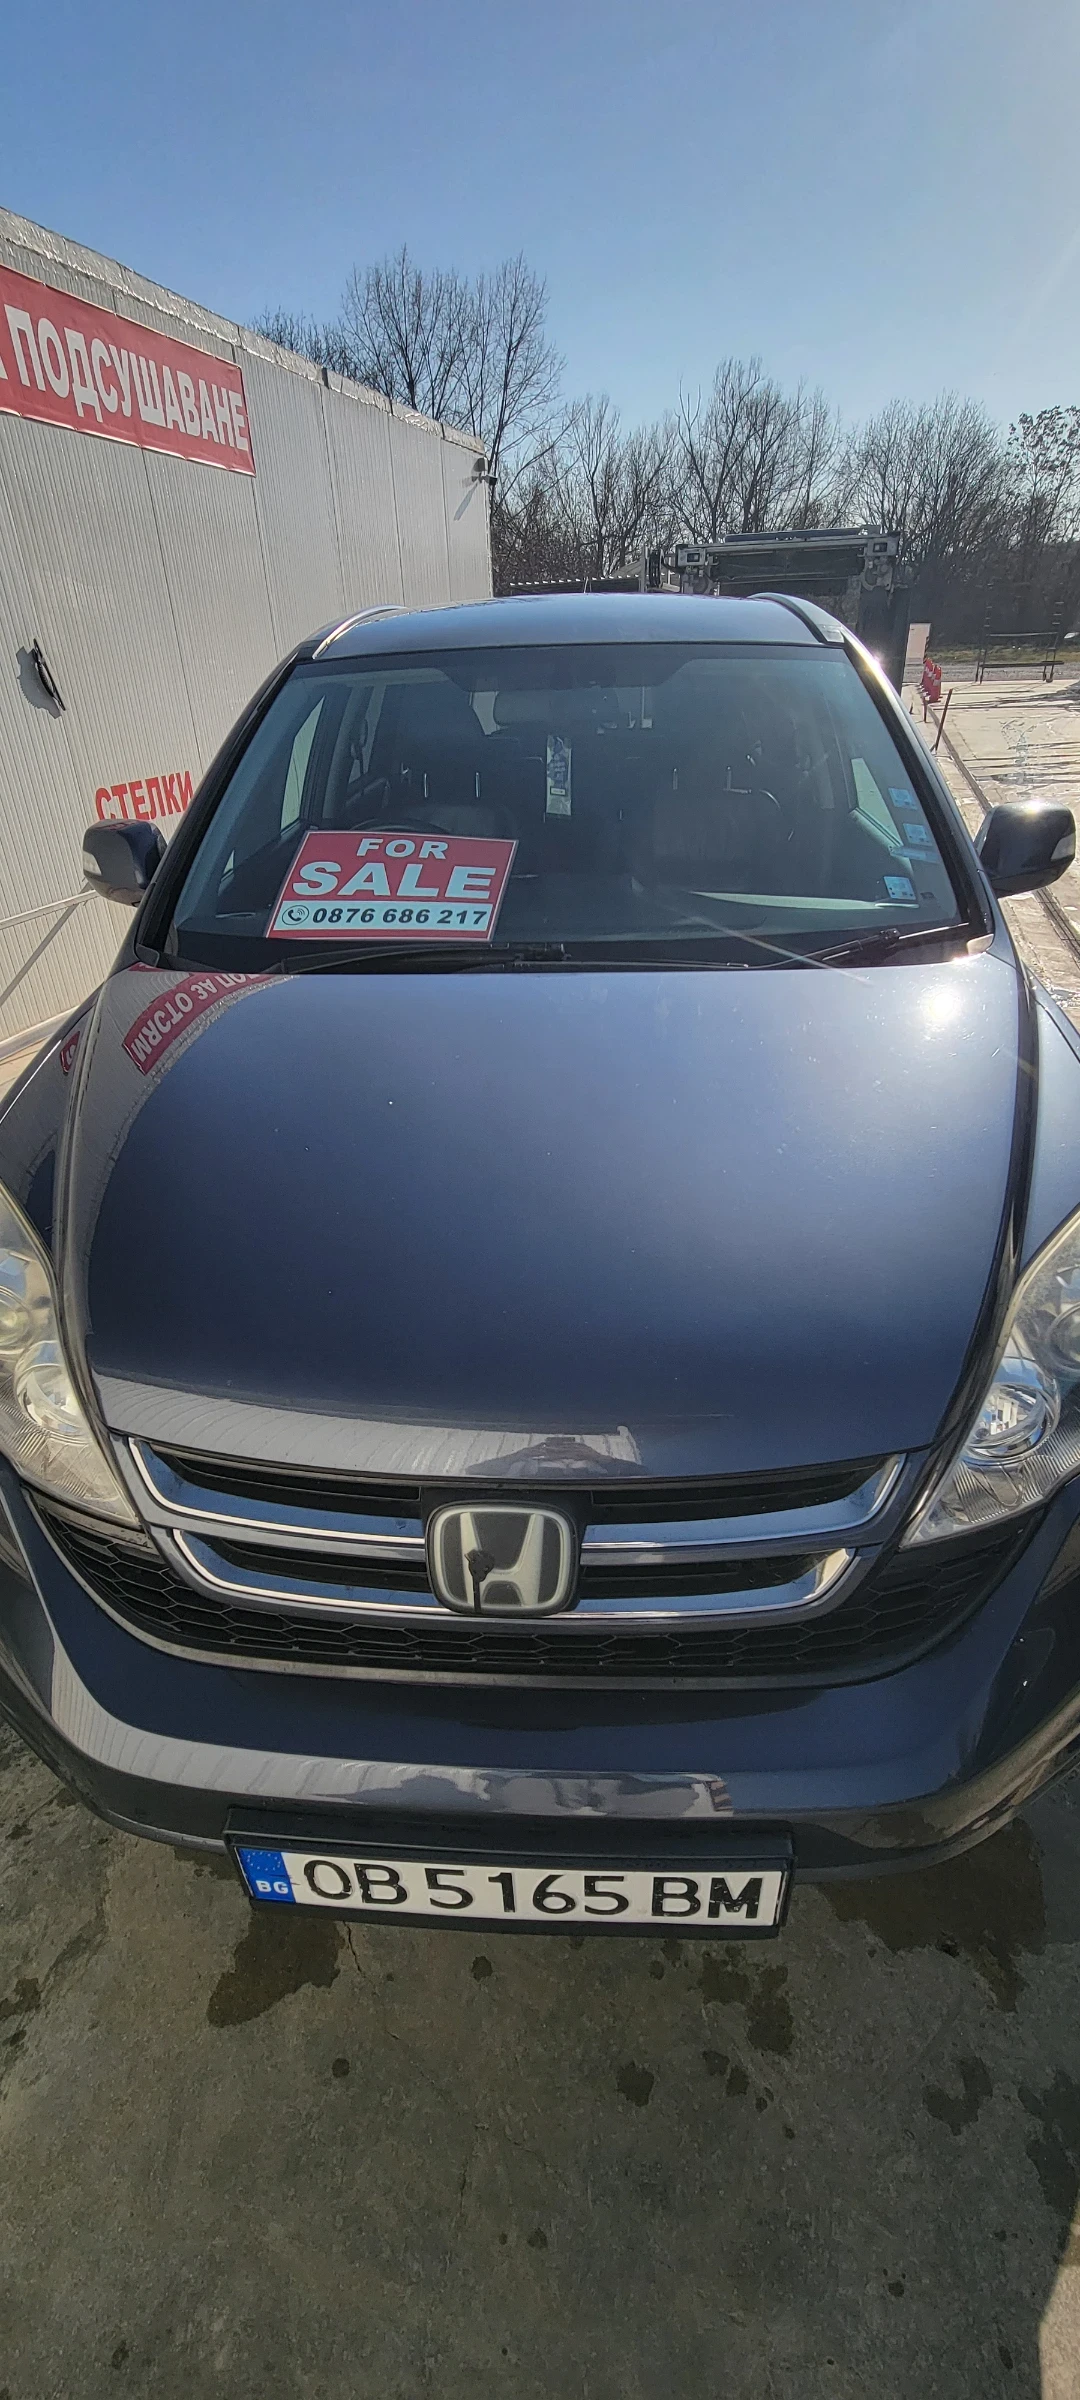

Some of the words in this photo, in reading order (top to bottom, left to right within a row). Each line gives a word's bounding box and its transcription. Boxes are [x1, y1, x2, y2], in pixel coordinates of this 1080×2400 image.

[4, 304, 249, 451] ПОДСУШАВАНЕ
[95, 770, 194, 820] СТЕЛКИ
[356, 838, 449, 860] FOR
[292, 861, 497, 900] SALE
[312, 907, 376, 924] 0876
[382, 908, 431, 924] 686
[437, 909, 487, 925] 217
[255, 1880, 290, 1895] BG
[303, 1860, 408, 1905] OB
[426, 1867, 630, 1916] 5165
[652, 1876, 763, 1919] BM
